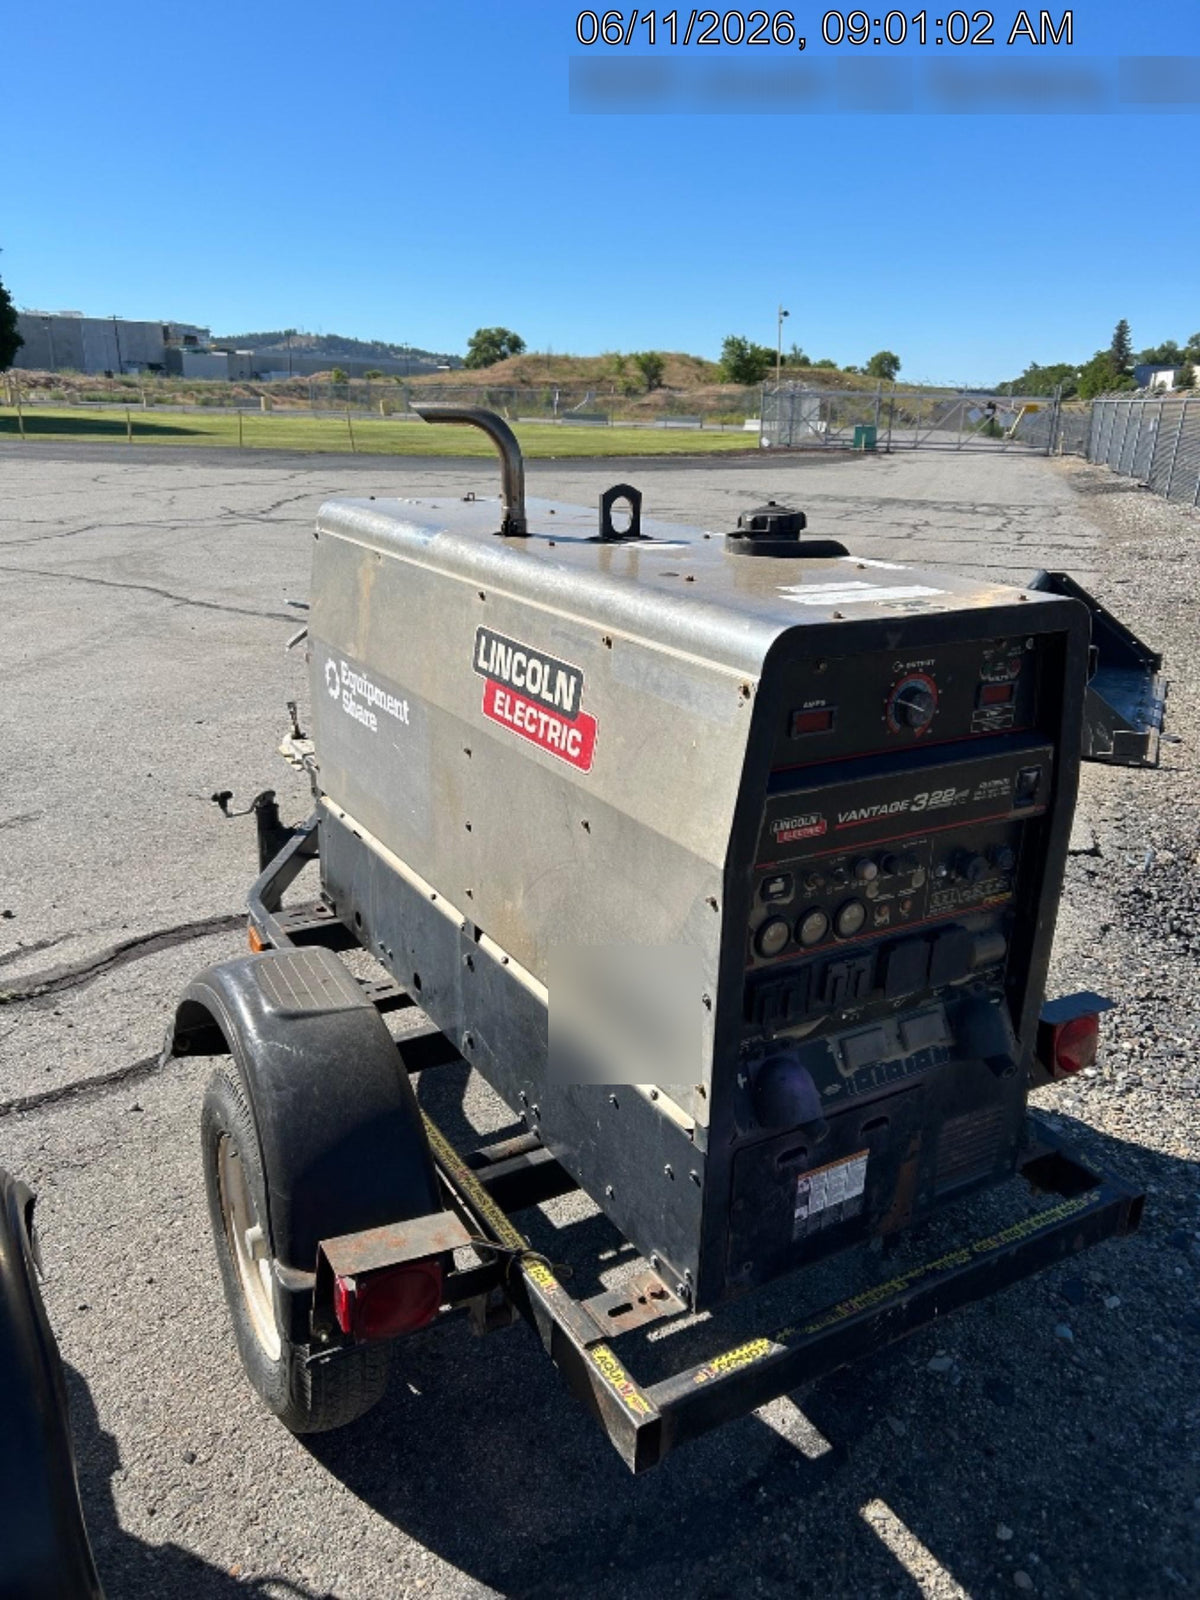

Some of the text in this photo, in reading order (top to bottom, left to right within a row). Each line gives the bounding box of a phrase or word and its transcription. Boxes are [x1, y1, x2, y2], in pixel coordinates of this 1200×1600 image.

[340, 659, 409, 725] Equipment
[477, 635, 578, 712] LINCOLN
[342, 688, 377, 733] Share
[493, 689, 583, 758] ELECTRIC
[772, 815, 819, 833] LINCOLN
[838, 800, 910, 823] VANTAGE
